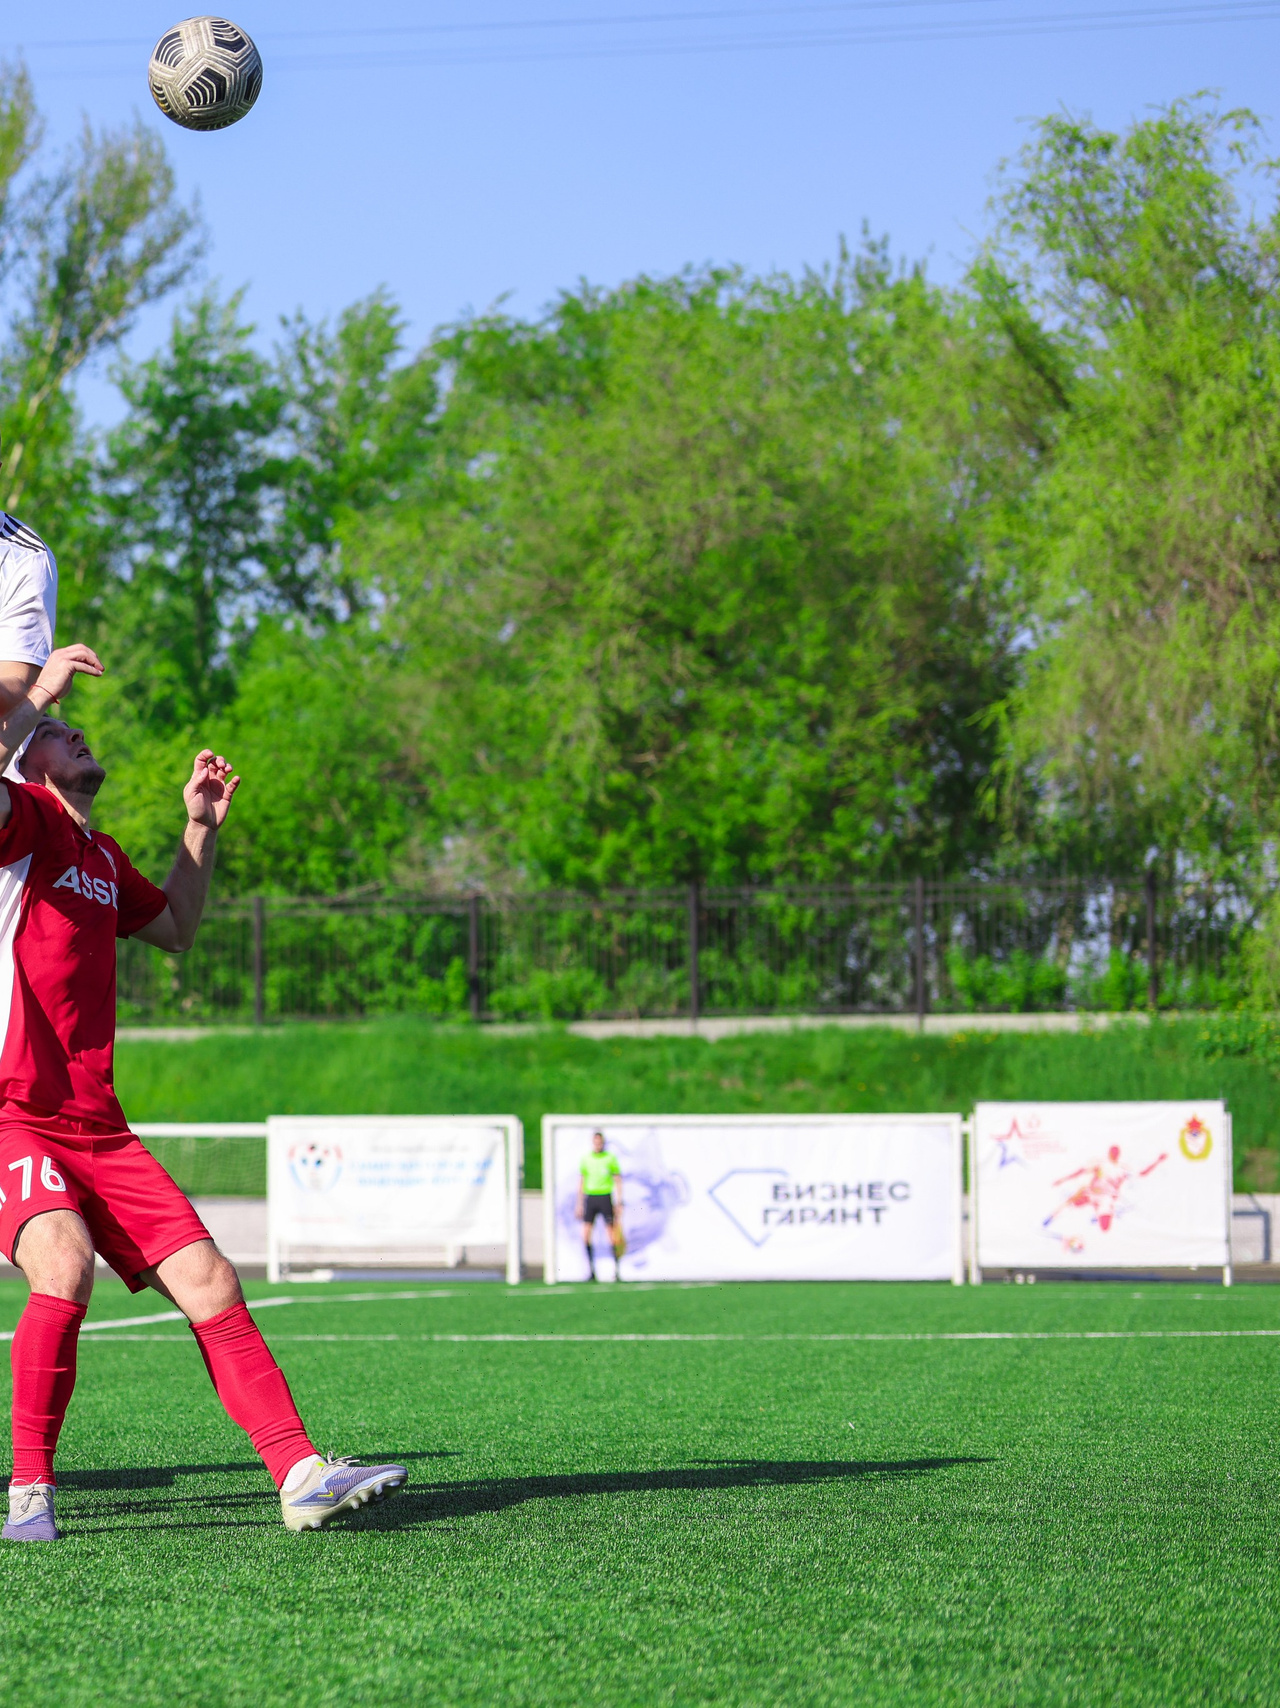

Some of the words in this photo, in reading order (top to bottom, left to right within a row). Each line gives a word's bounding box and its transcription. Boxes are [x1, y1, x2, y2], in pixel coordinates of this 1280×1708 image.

[8, 1155, 67, 1202] 76
[772, 1181, 911, 1202] БИЗНЕС
[762, 1205, 890, 1226] ГАРАНТ
